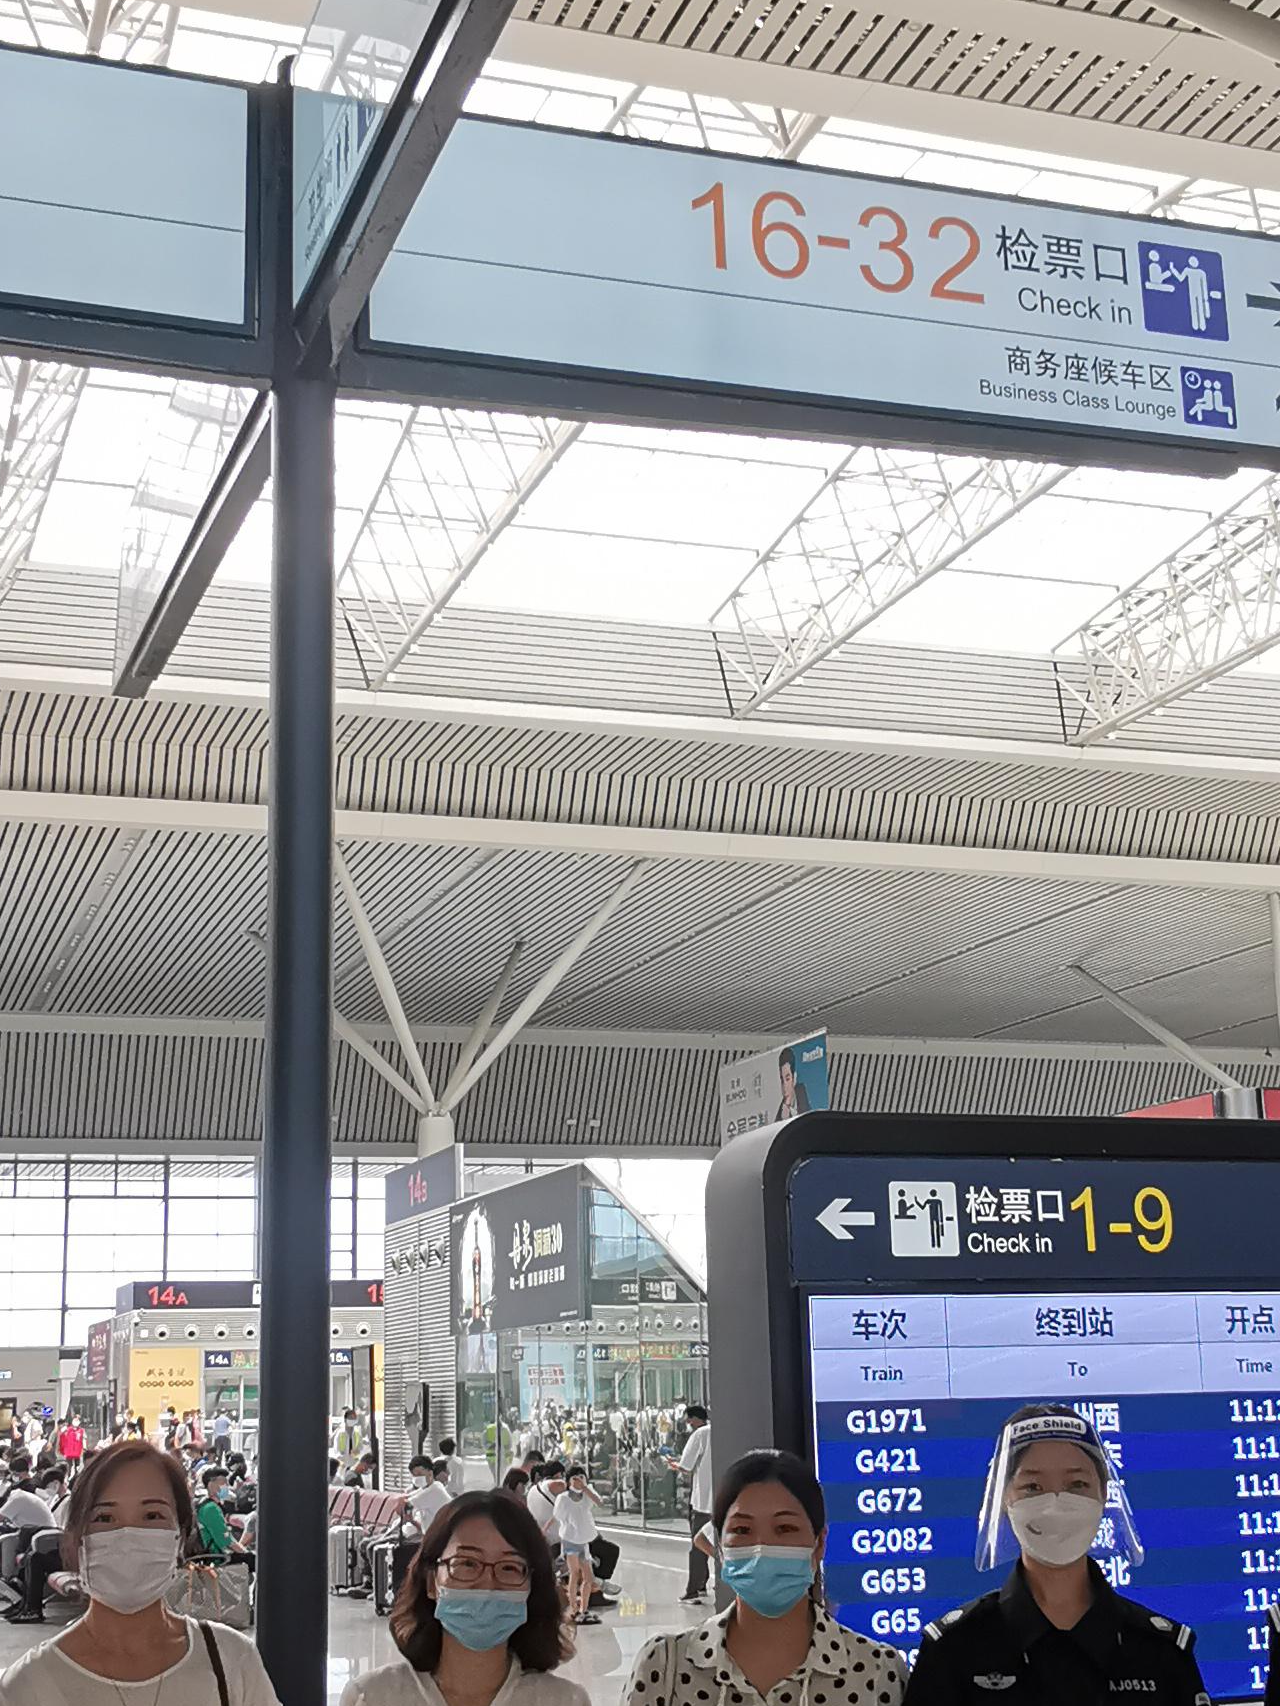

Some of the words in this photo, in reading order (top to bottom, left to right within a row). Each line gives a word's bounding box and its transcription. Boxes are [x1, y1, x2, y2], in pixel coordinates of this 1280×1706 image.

[690, 181, 985, 305] 16-32
[995, 225, 1131, 286] 检票口
[1017, 287, 1102, 323] Check
[1110, 296, 1133, 325] in
[1004, 345, 1175, 394] 商务座候车区
[979, 378, 1058, 408] Business
[1062, 388, 1111, 412] Class
[1114, 393, 1177, 421] Lounge
[965, 1186, 1065, 1224] 检票口
[1070, 1185, 1173, 1254] 1-9
[968, 1232, 1030, 1254] Check
[1036, 1233, 1052, 1253] in
[148, 1285, 188, 1306] 14A
[852, 1309, 907, 1341] 车次
[1035, 1306, 1114, 1338] 终到站
[1225, 1305, 1276, 1335] 开点
[860, 1365, 904, 1382] Train
[1068, 1361, 1088, 1378] To
[1236, 1357, 1273, 1374] Time
[846, 1407, 927, 1435] G1971
[1013, 1422, 1039, 1435] Face
[1043, 1419, 1081, 1431] Shield
[855, 1447, 921, 1474] G421
[857, 1486, 923, 1514] G672
[851, 1526, 933, 1554] G2082
[861, 1567, 927, 1595] G653
